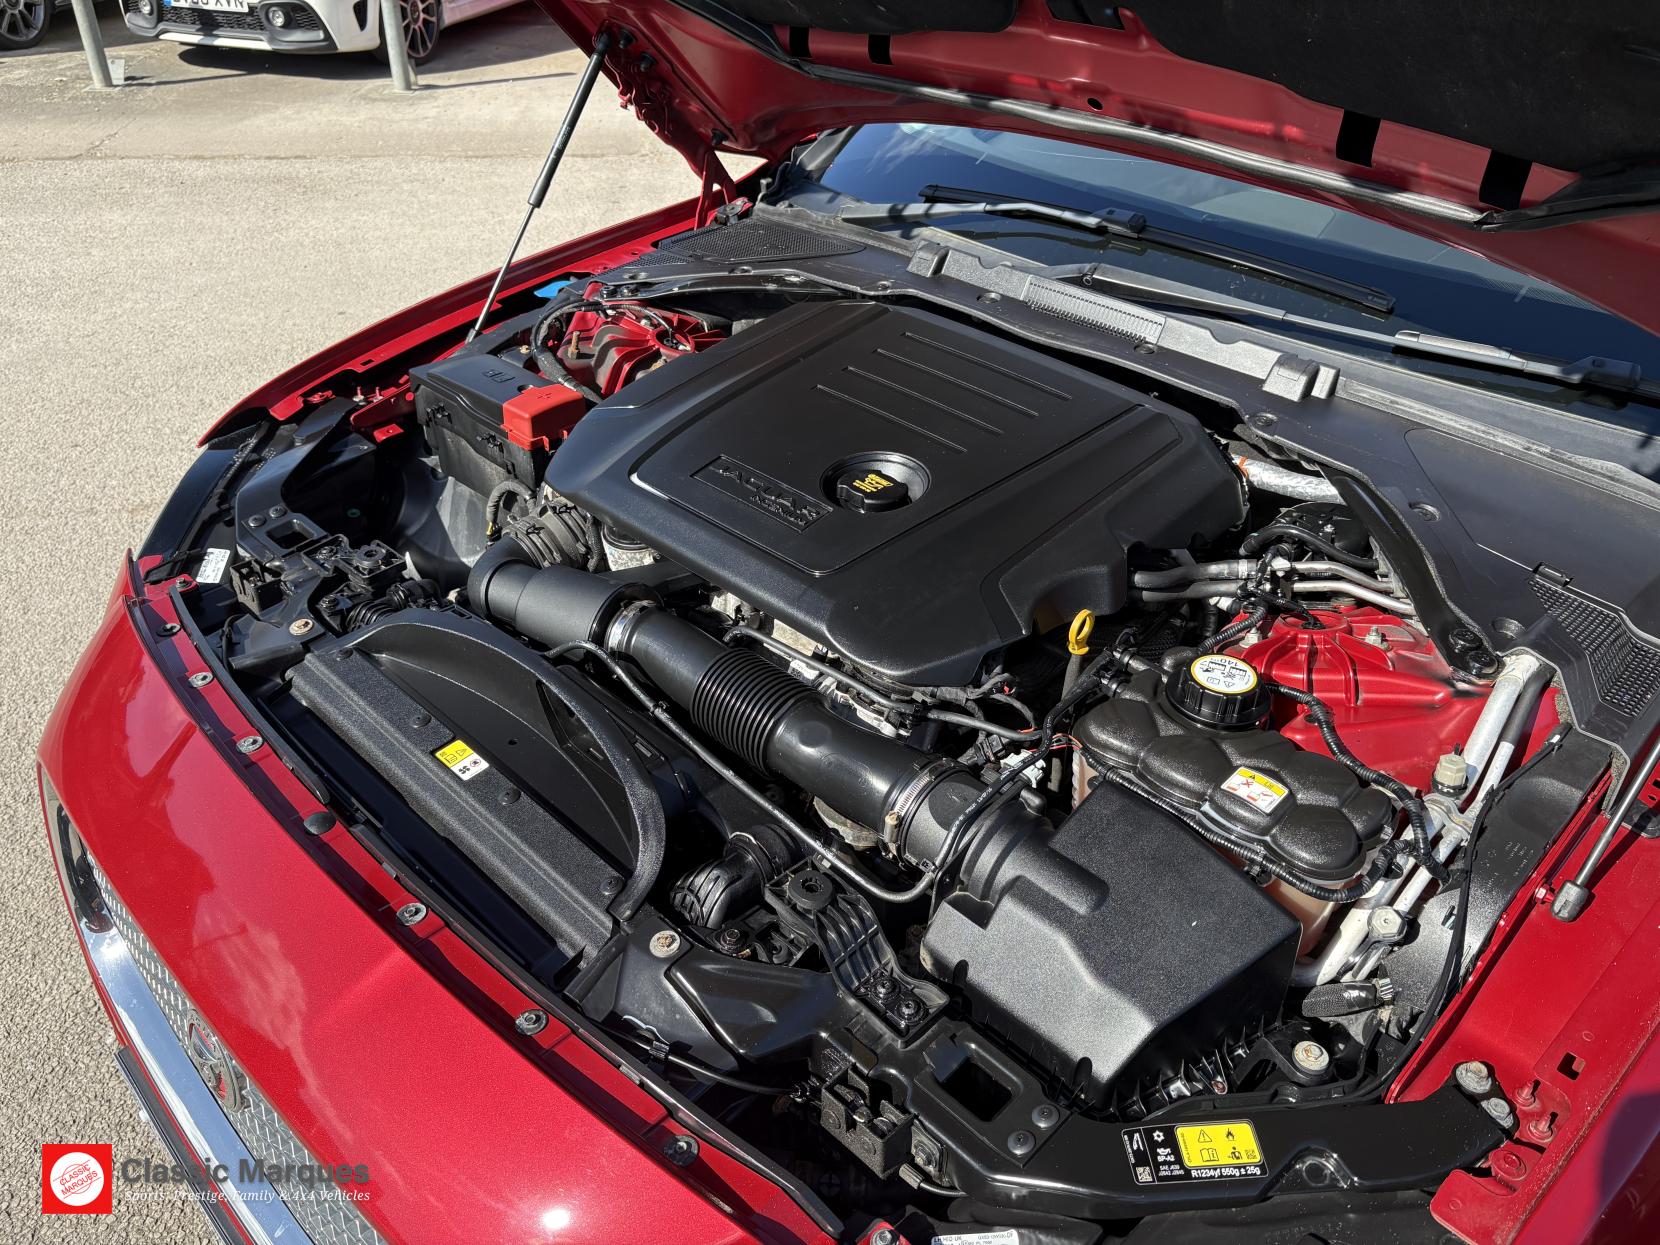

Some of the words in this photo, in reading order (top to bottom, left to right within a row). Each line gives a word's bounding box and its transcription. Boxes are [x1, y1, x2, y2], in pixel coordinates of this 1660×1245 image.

[1191, 1168, 1220, 1178] R1234yf
[1221, 1167, 1240, 1177] 550g
[1246, 1165, 1261, 1176] 25g
